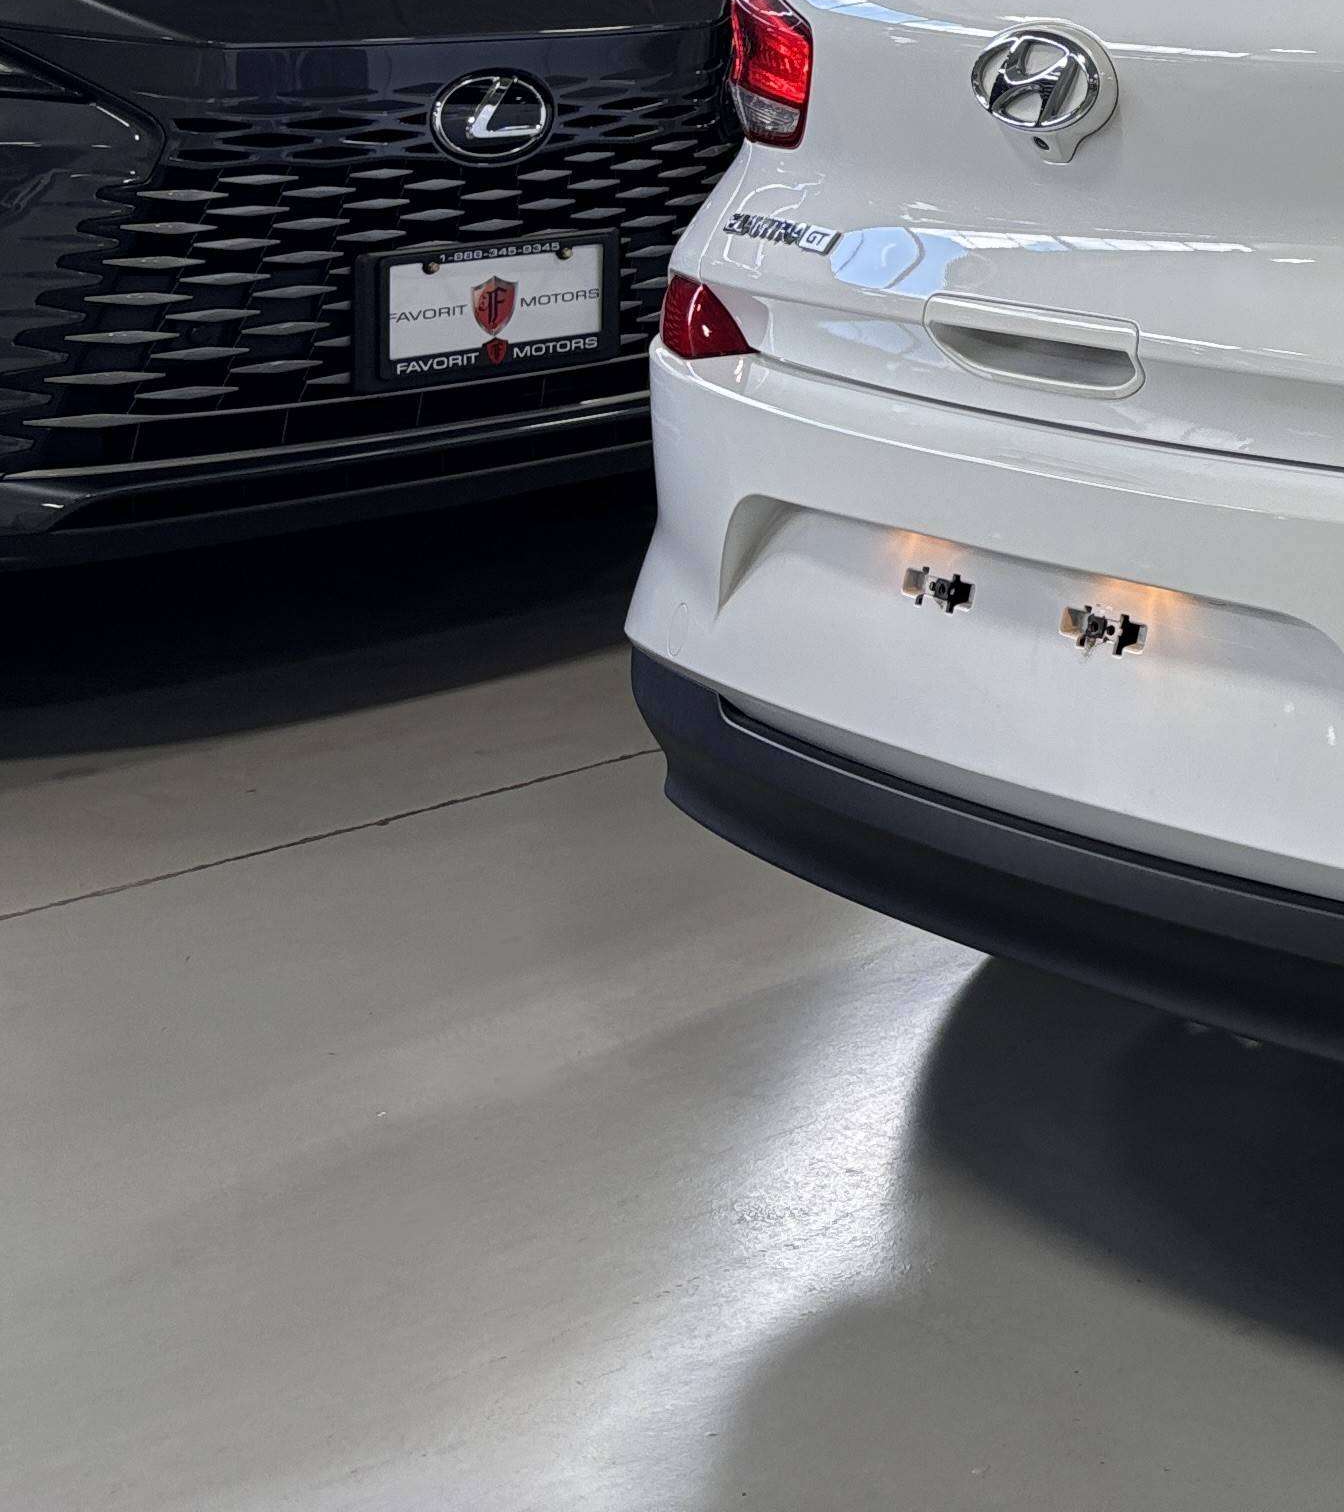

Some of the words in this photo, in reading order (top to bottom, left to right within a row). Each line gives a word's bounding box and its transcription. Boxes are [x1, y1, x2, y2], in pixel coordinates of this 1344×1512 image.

[520, 288, 600, 308] MOTORS
[396, 352, 480, 375] FAVORIT
[513, 337, 598, 359] MOTORS
